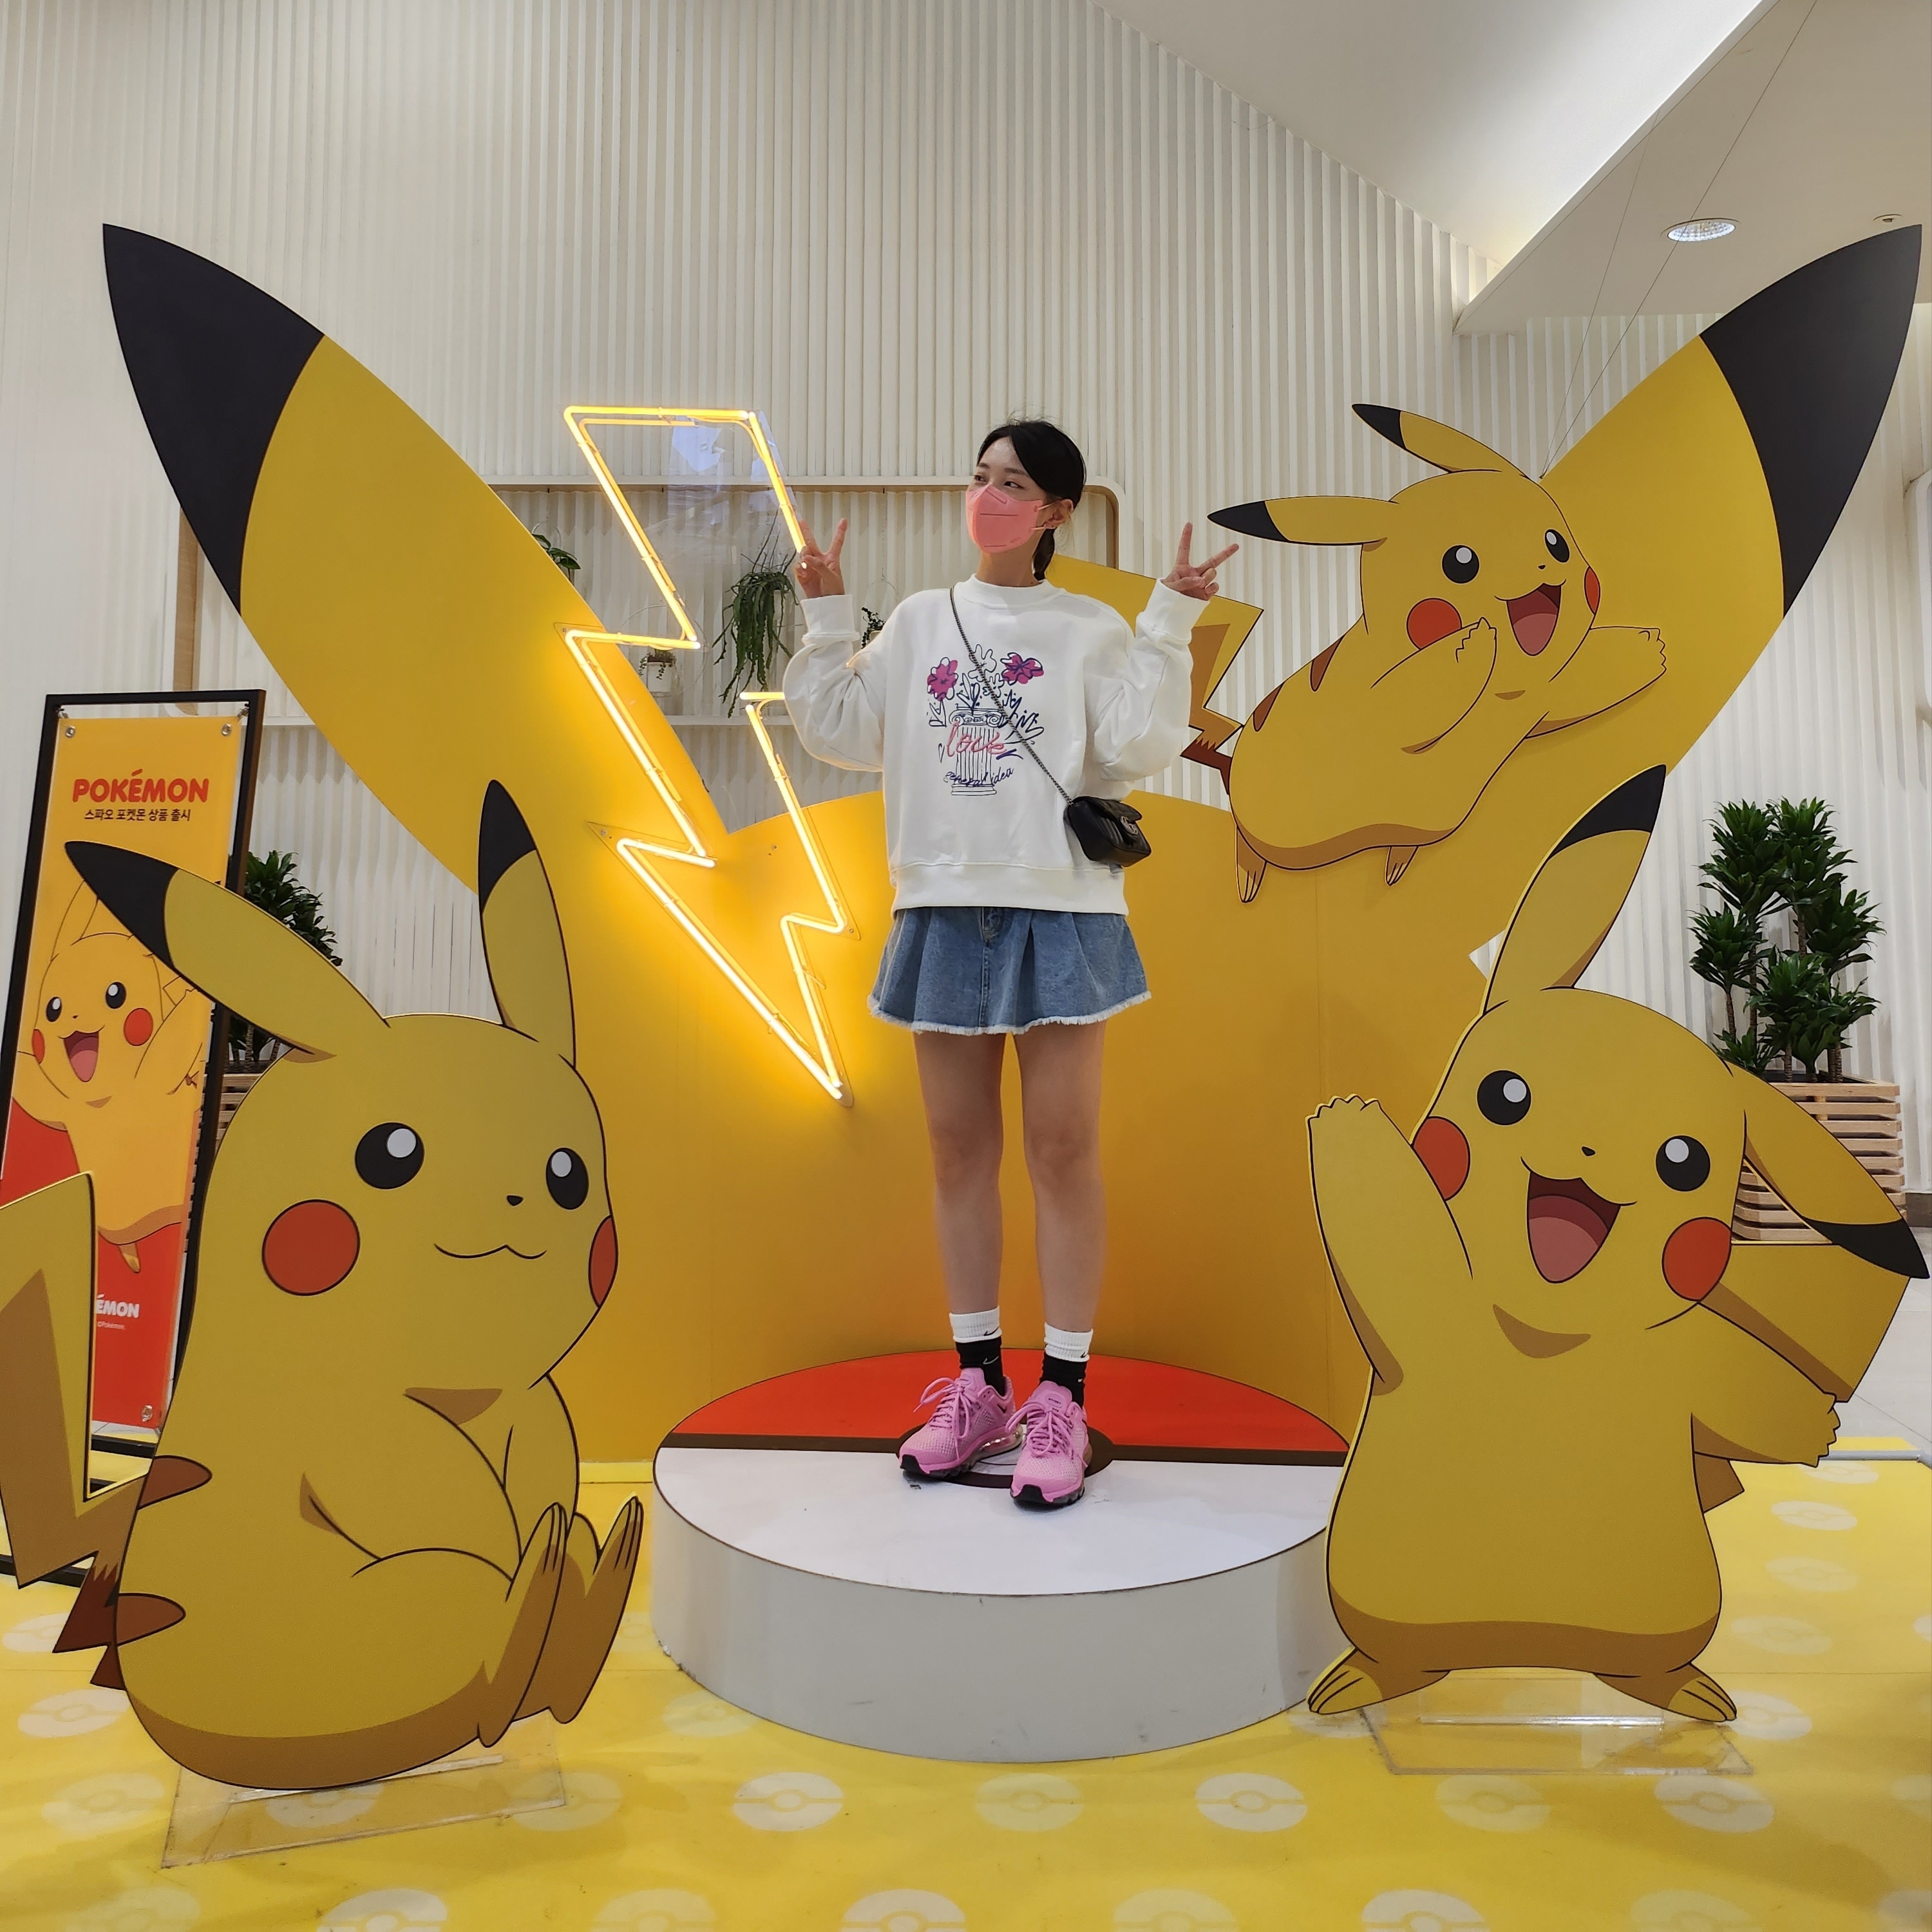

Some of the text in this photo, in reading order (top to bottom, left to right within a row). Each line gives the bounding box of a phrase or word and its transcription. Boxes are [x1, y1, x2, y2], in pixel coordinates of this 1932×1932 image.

[72, 768, 209, 803] POKÉMON
[991, 766, 1014, 784] idea
[84, 809, 191, 821] 스파오 포켓몬 상품 출시
[96, 1294, 140, 1318] ÉMON
